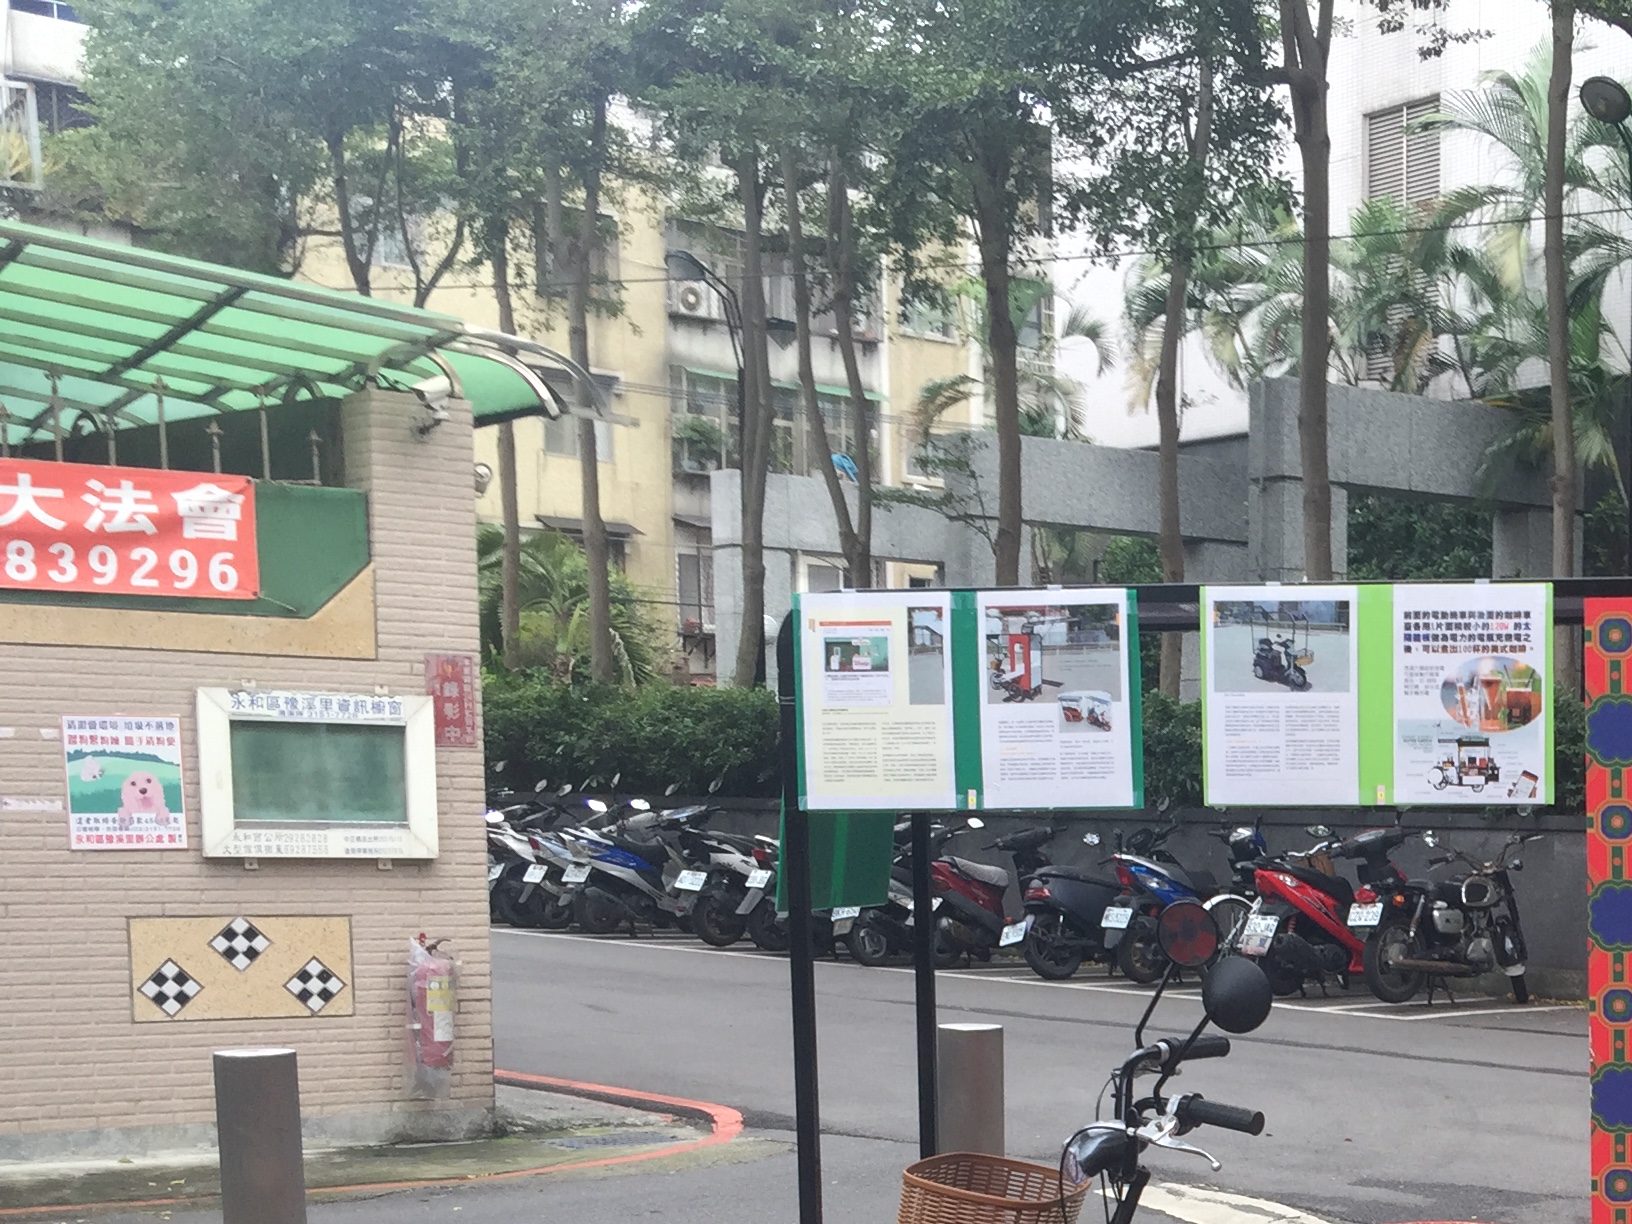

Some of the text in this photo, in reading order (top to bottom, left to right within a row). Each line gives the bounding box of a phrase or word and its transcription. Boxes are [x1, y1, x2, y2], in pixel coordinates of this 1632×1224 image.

[0, 473, 245, 541] 大法會
[5, 539, 239, 592] 839296
